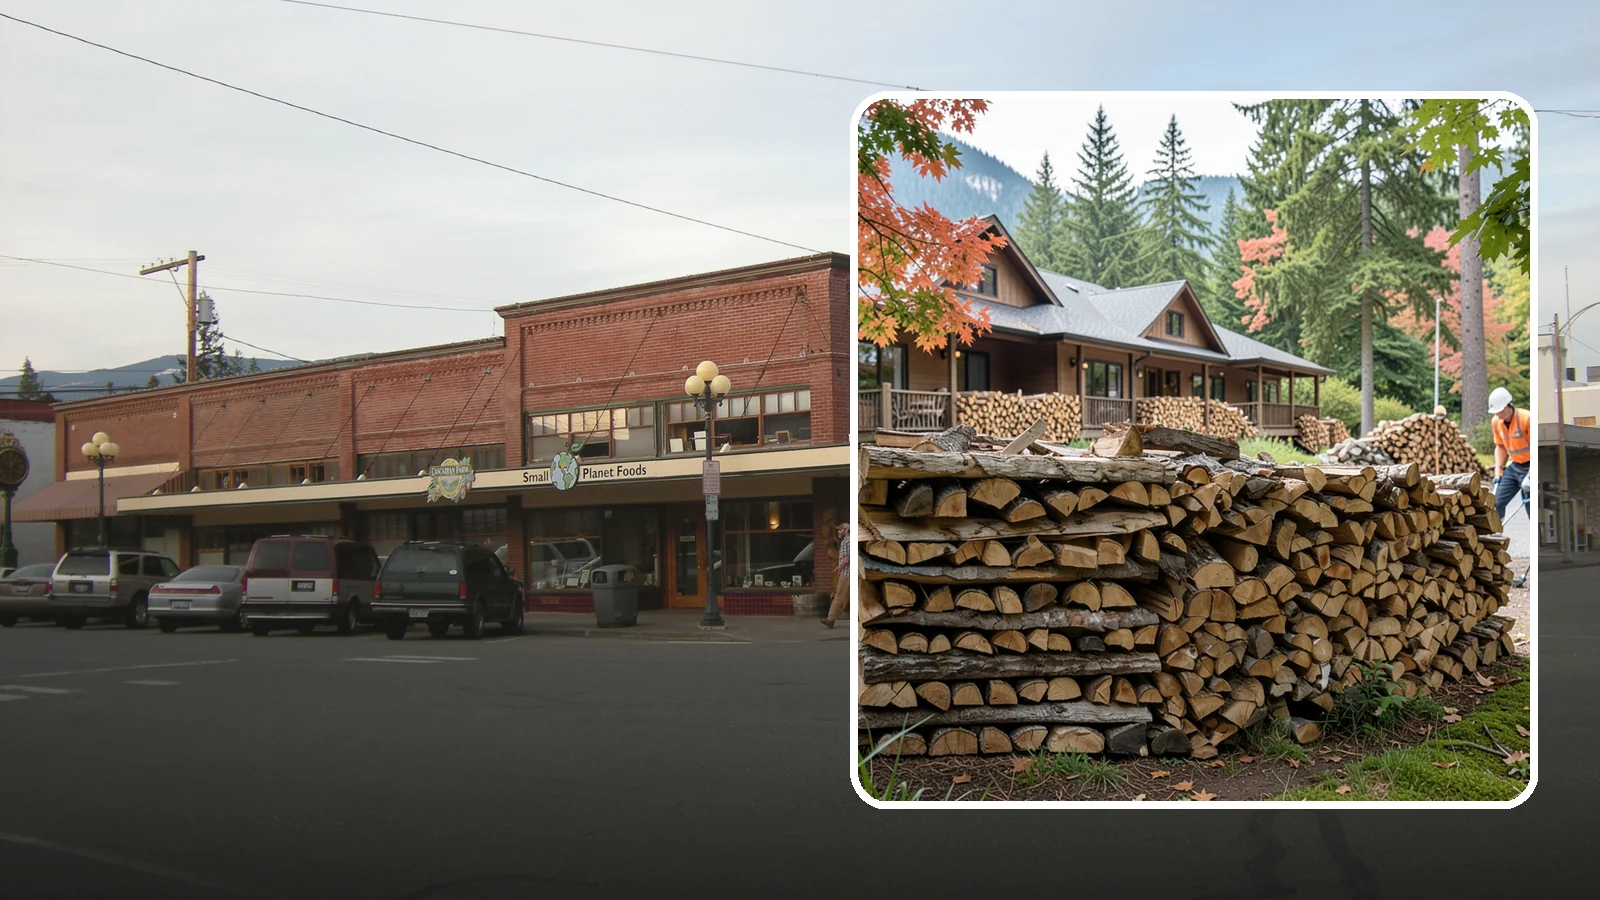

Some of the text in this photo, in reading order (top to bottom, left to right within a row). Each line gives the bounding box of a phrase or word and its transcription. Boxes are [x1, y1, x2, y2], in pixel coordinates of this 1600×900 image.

[523, 464, 646, 482] Small Planet Foods
